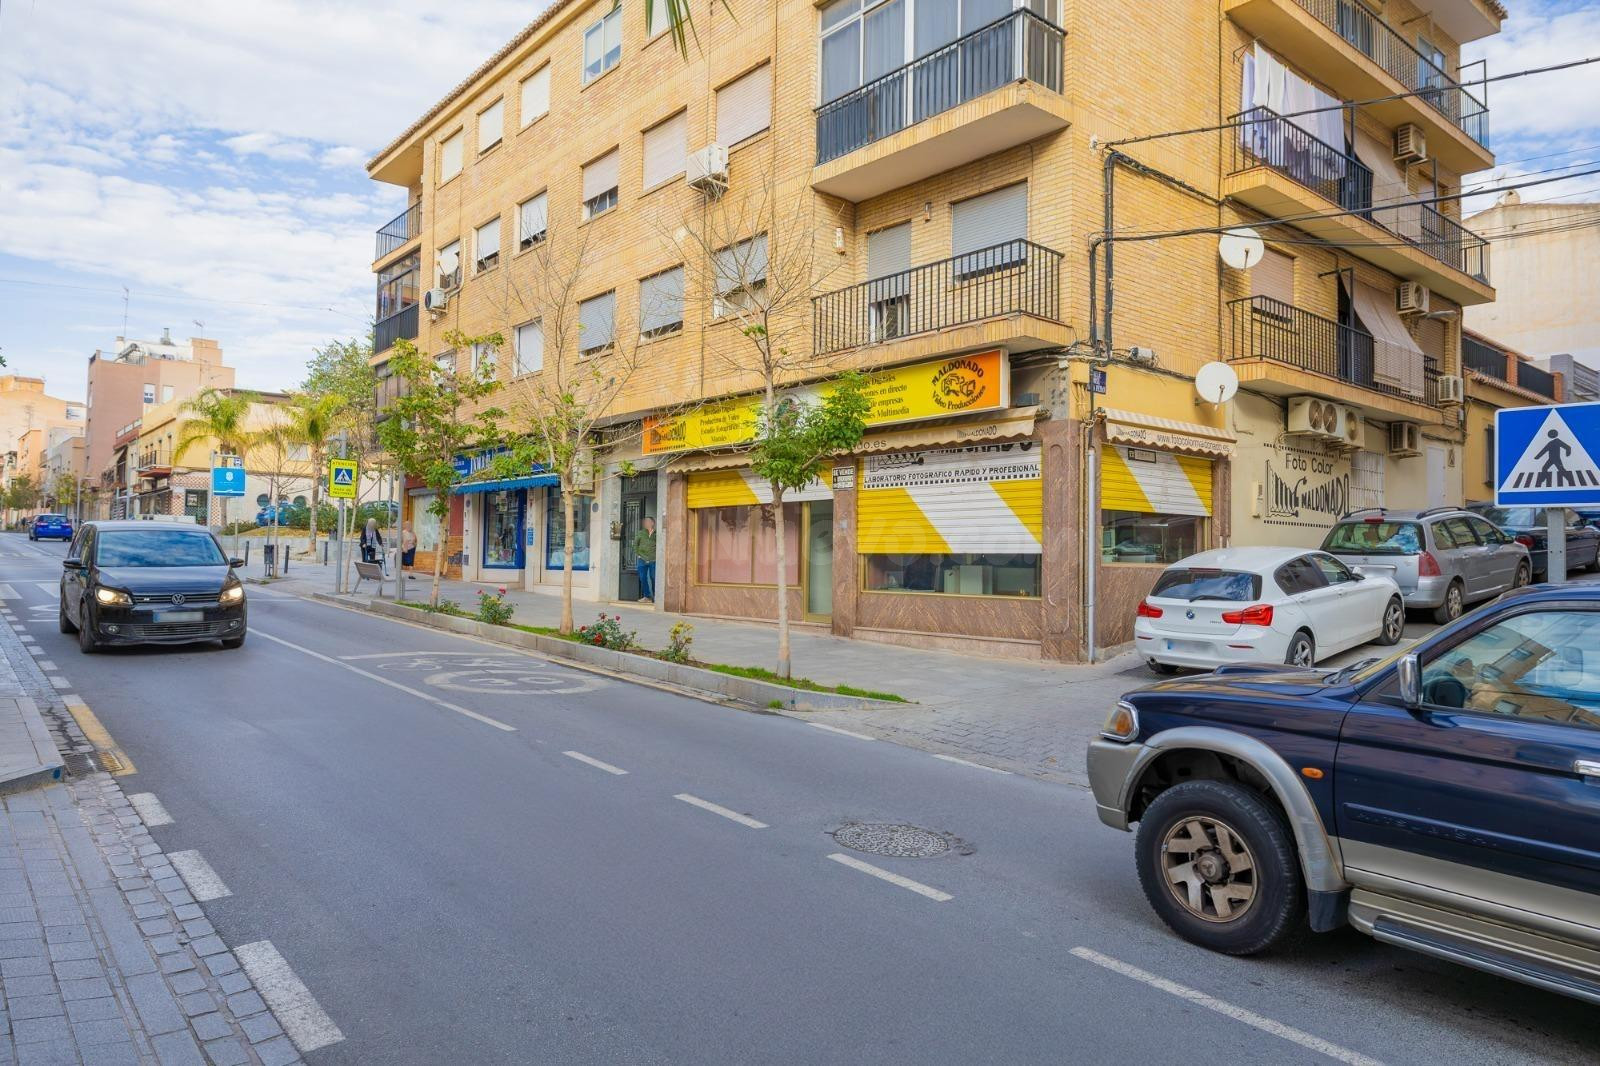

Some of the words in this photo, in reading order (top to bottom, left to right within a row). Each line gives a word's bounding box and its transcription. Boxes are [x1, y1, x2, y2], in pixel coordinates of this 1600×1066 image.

[931, 360, 984, 386] MALDONADO
[878, 397, 904, 407] empresas
[948, 385, 986, 410] Producciones
[877, 406, 910, 417] Multimedia
[864, 474, 907, 483] LABORATORIO
[908, 470, 953, 480] FOTOGRAFICO
[954, 468, 980, 477] RAPIDO
[982, 467, 987, 475] Y
[988, 464, 1039, 474] PROFESIONAL
[1285, 453, 1307, 472] Foto
[1311, 457, 1333, 475] Color
[1301, 473, 1350, 517] MALDONADO
[468, 676, 564, 686] 30
